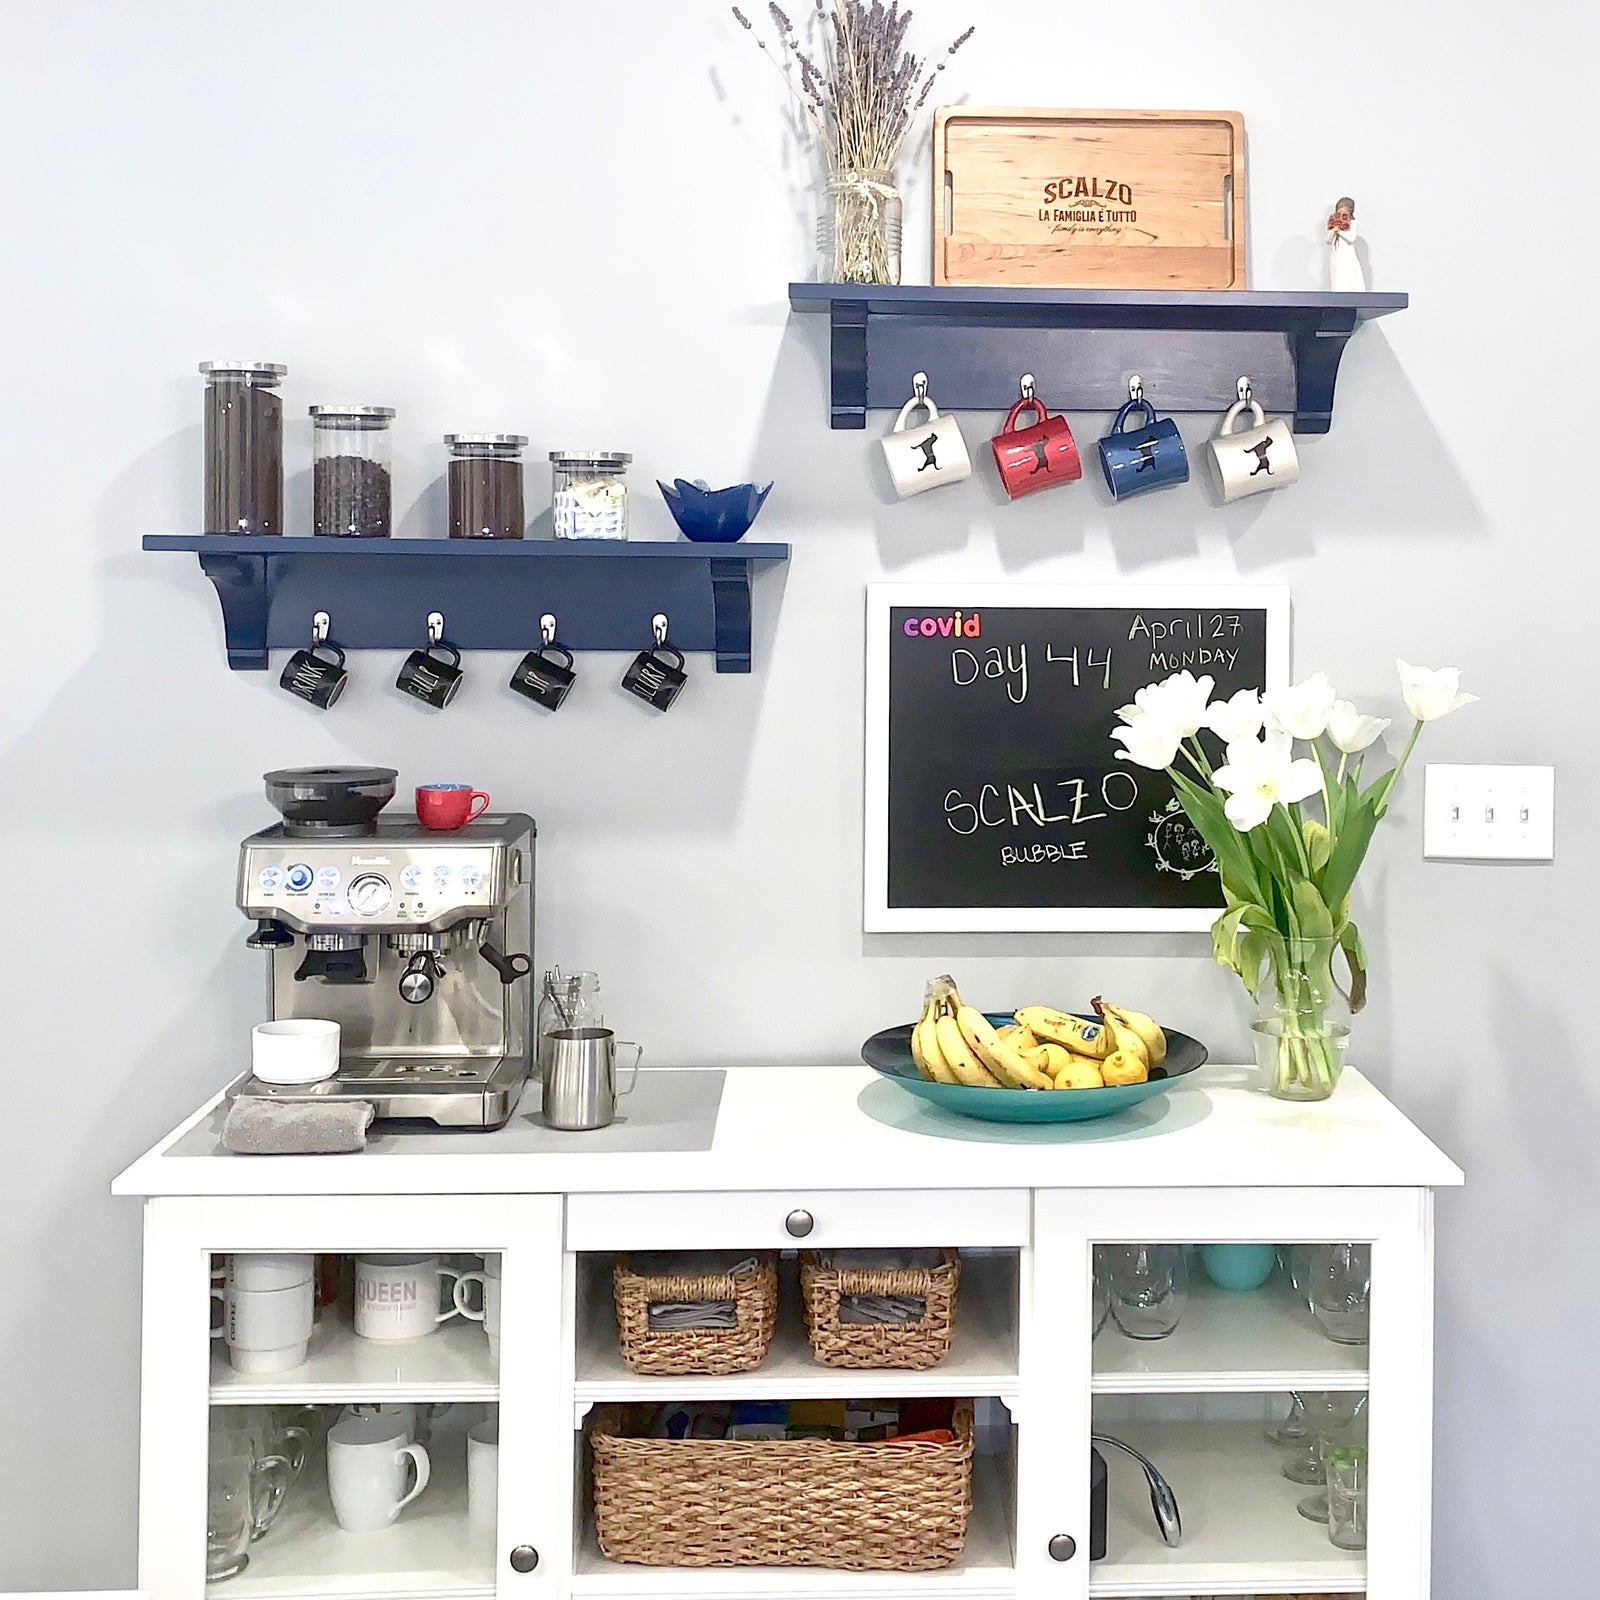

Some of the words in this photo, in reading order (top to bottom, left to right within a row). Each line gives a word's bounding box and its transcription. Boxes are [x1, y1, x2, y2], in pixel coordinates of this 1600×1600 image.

[1044, 176, 1132, 206] SCALZO
[1038, 208, 1050, 222] LA
[1053, 208, 1096, 222] FAMIGLIA
[1106, 209, 1137, 223] TUTTO
[903, 610, 982, 638] covid
[1128, 614, 1202, 650] April
[1209, 614, 1244, 641] 27
[951, 642, 1028, 704] Day
[1046, 643, 1113, 690] 44
[1149, 647, 1240, 672] MONDAY
[290, 659, 328, 701] DRINK
[407, 665, 441, 700] GULP
[523, 671, 550, 695] SIP
[631, 662, 668, 702] SLURP
[943, 771, 1138, 836] SCALZO
[1000, 840, 1089, 867] BUBBLE
